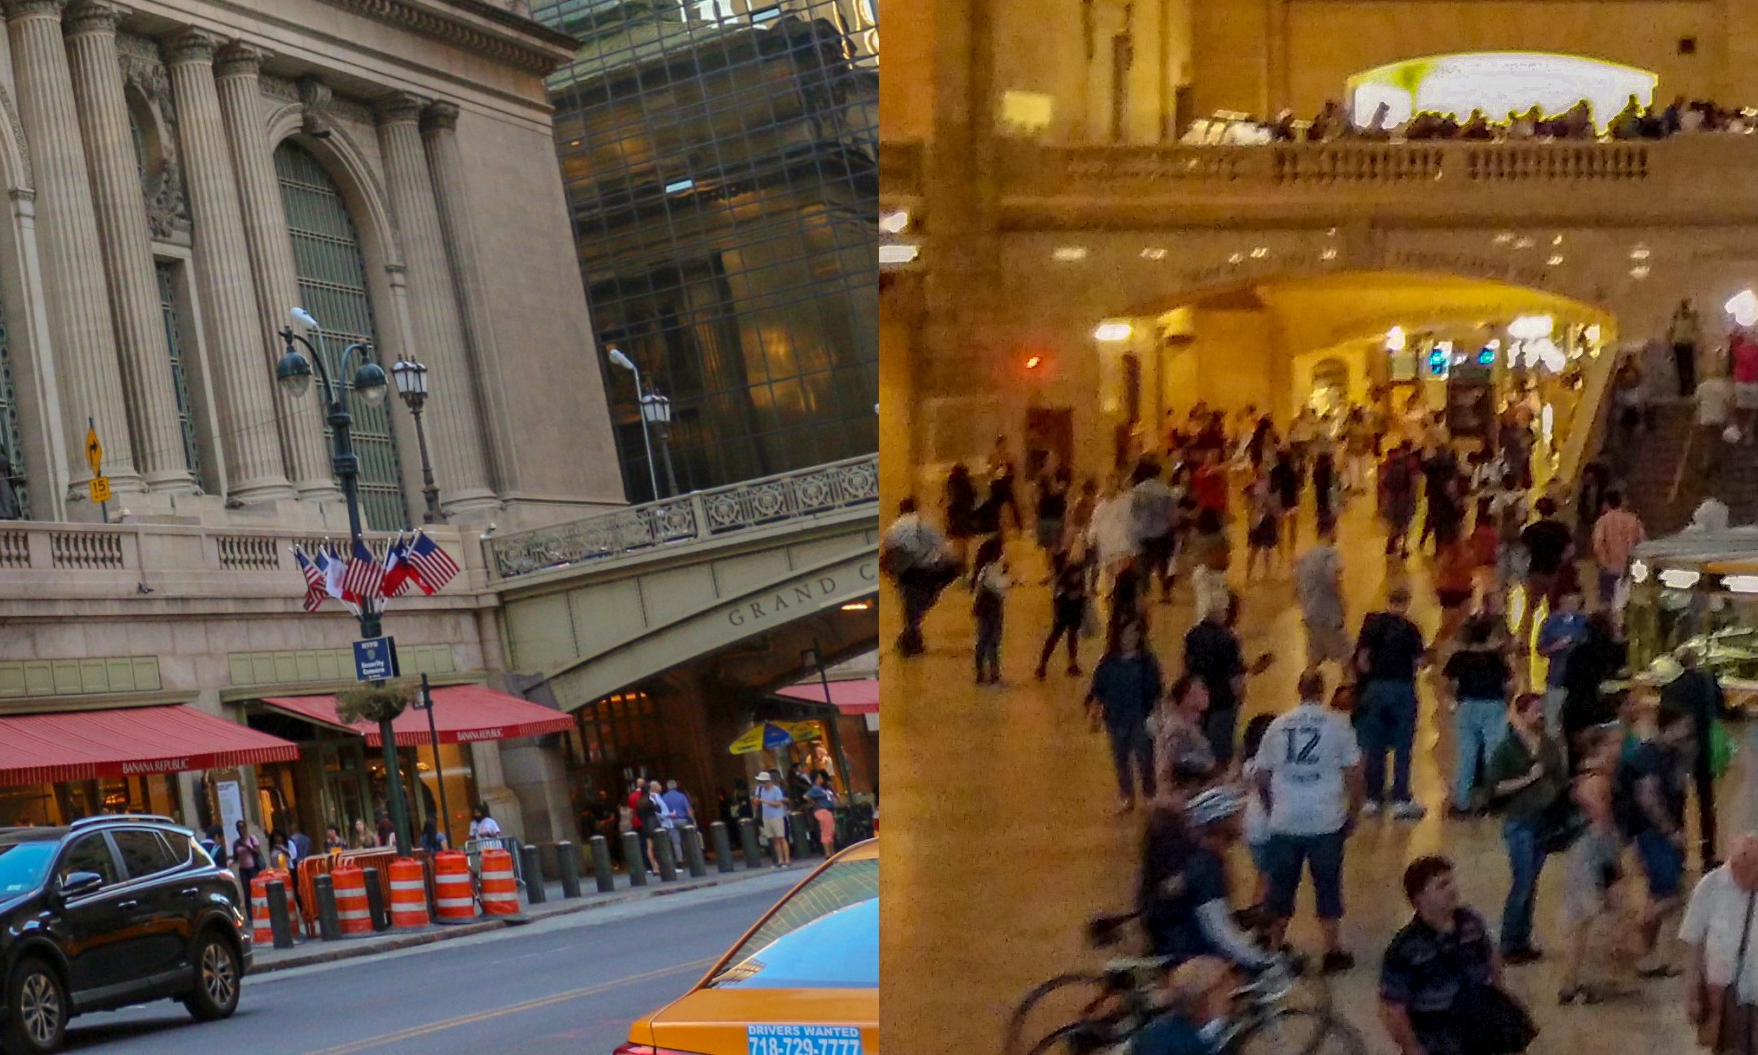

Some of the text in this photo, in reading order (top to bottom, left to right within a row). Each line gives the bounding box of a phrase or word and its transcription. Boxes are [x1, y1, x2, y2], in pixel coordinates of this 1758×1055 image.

[93, 480, 106, 492] 15
[729, 577, 836, 626] GRAND
[361, 641, 378, 649] NYPD
[361, 660, 384, 668] Security
[1283, 727, 1321, 764] 12
[122, 758, 189, 774] BANANA REPUBLIC
[748, 1025, 859, 1037] DRIVERS WANTED
[748, 1036, 860, 1055] 718-729-7777
